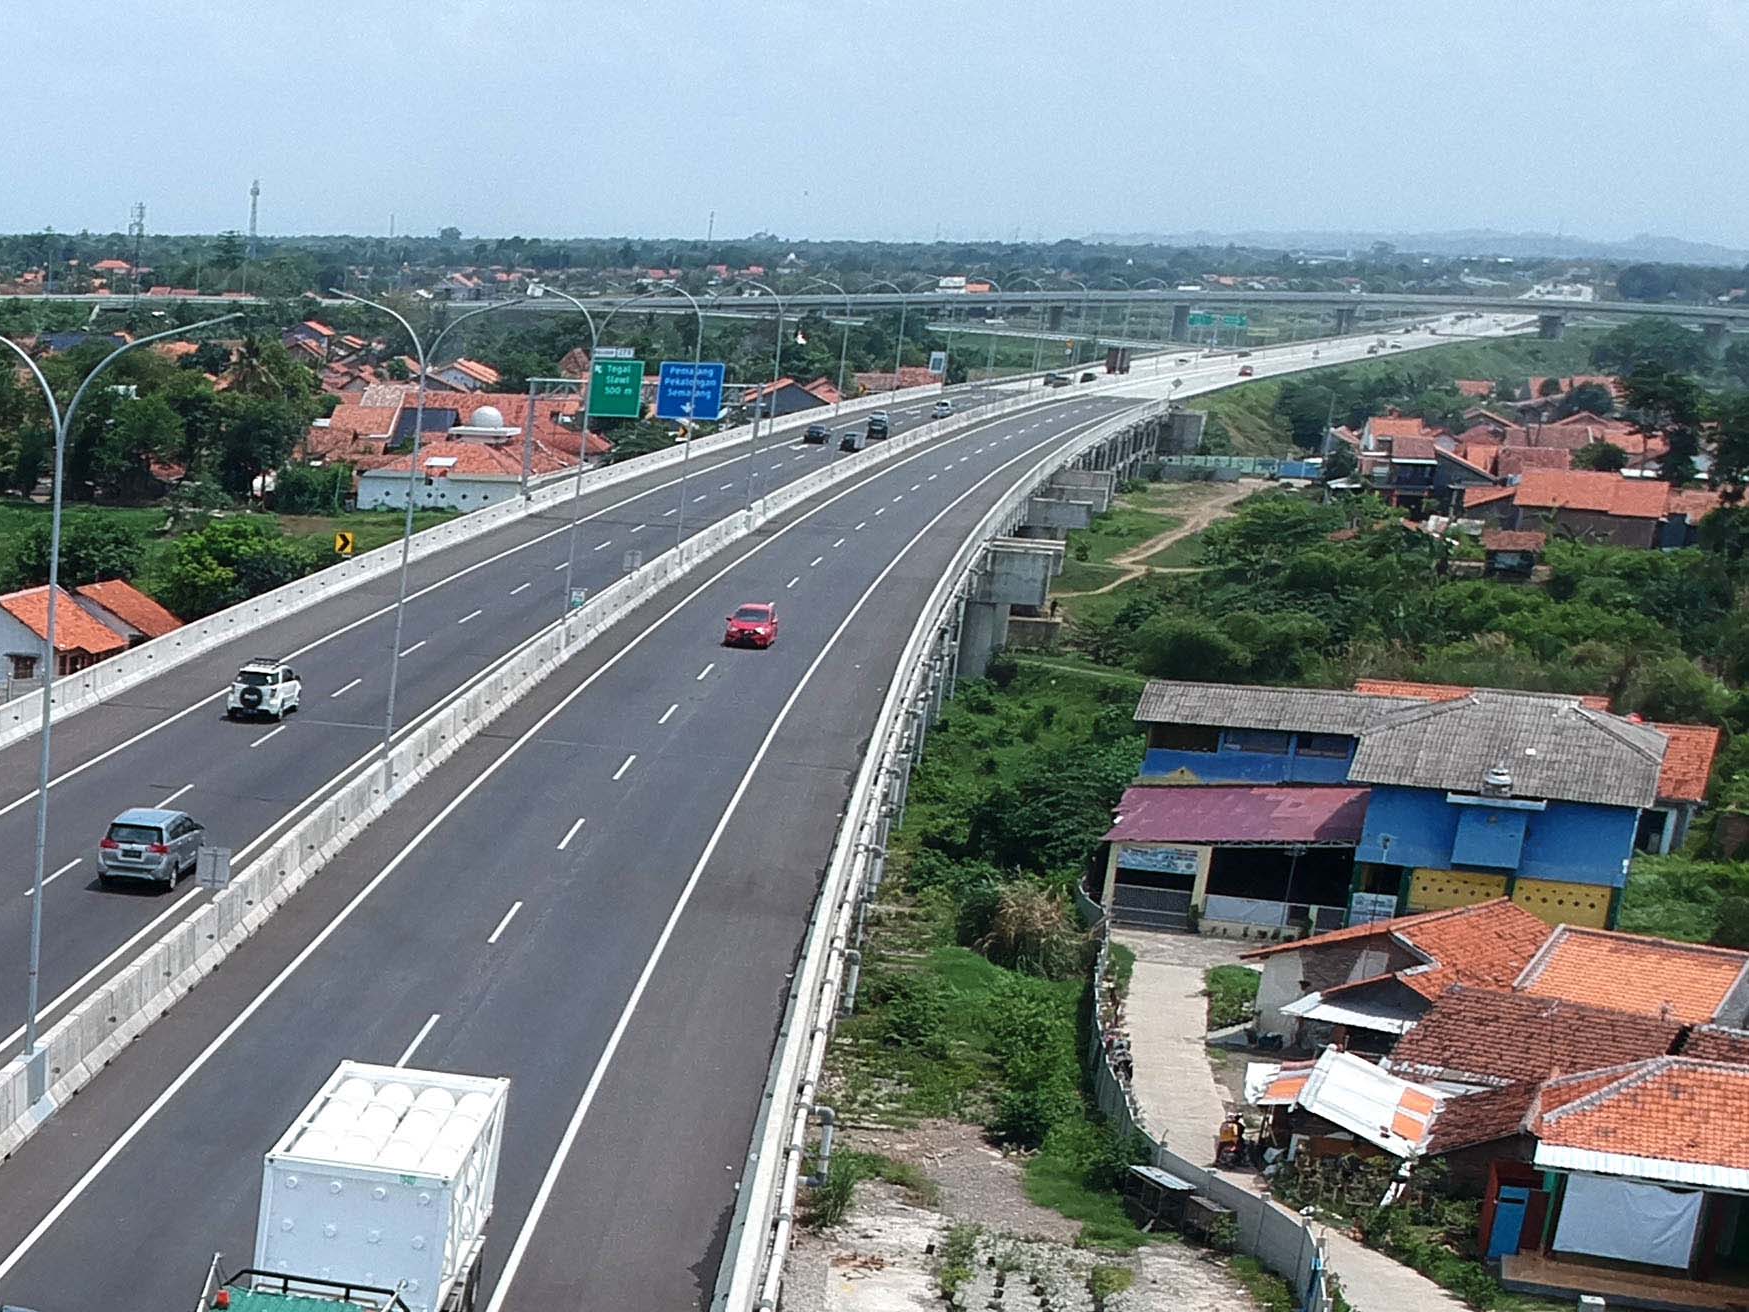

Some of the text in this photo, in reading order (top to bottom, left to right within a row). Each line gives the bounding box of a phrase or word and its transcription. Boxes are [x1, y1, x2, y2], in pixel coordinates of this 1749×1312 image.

[607, 364, 631, 375] Tegal
[669, 366, 714, 378] Pemaang
[604, 386, 621, 395] 500
[667, 388, 712, 400] Semaang
